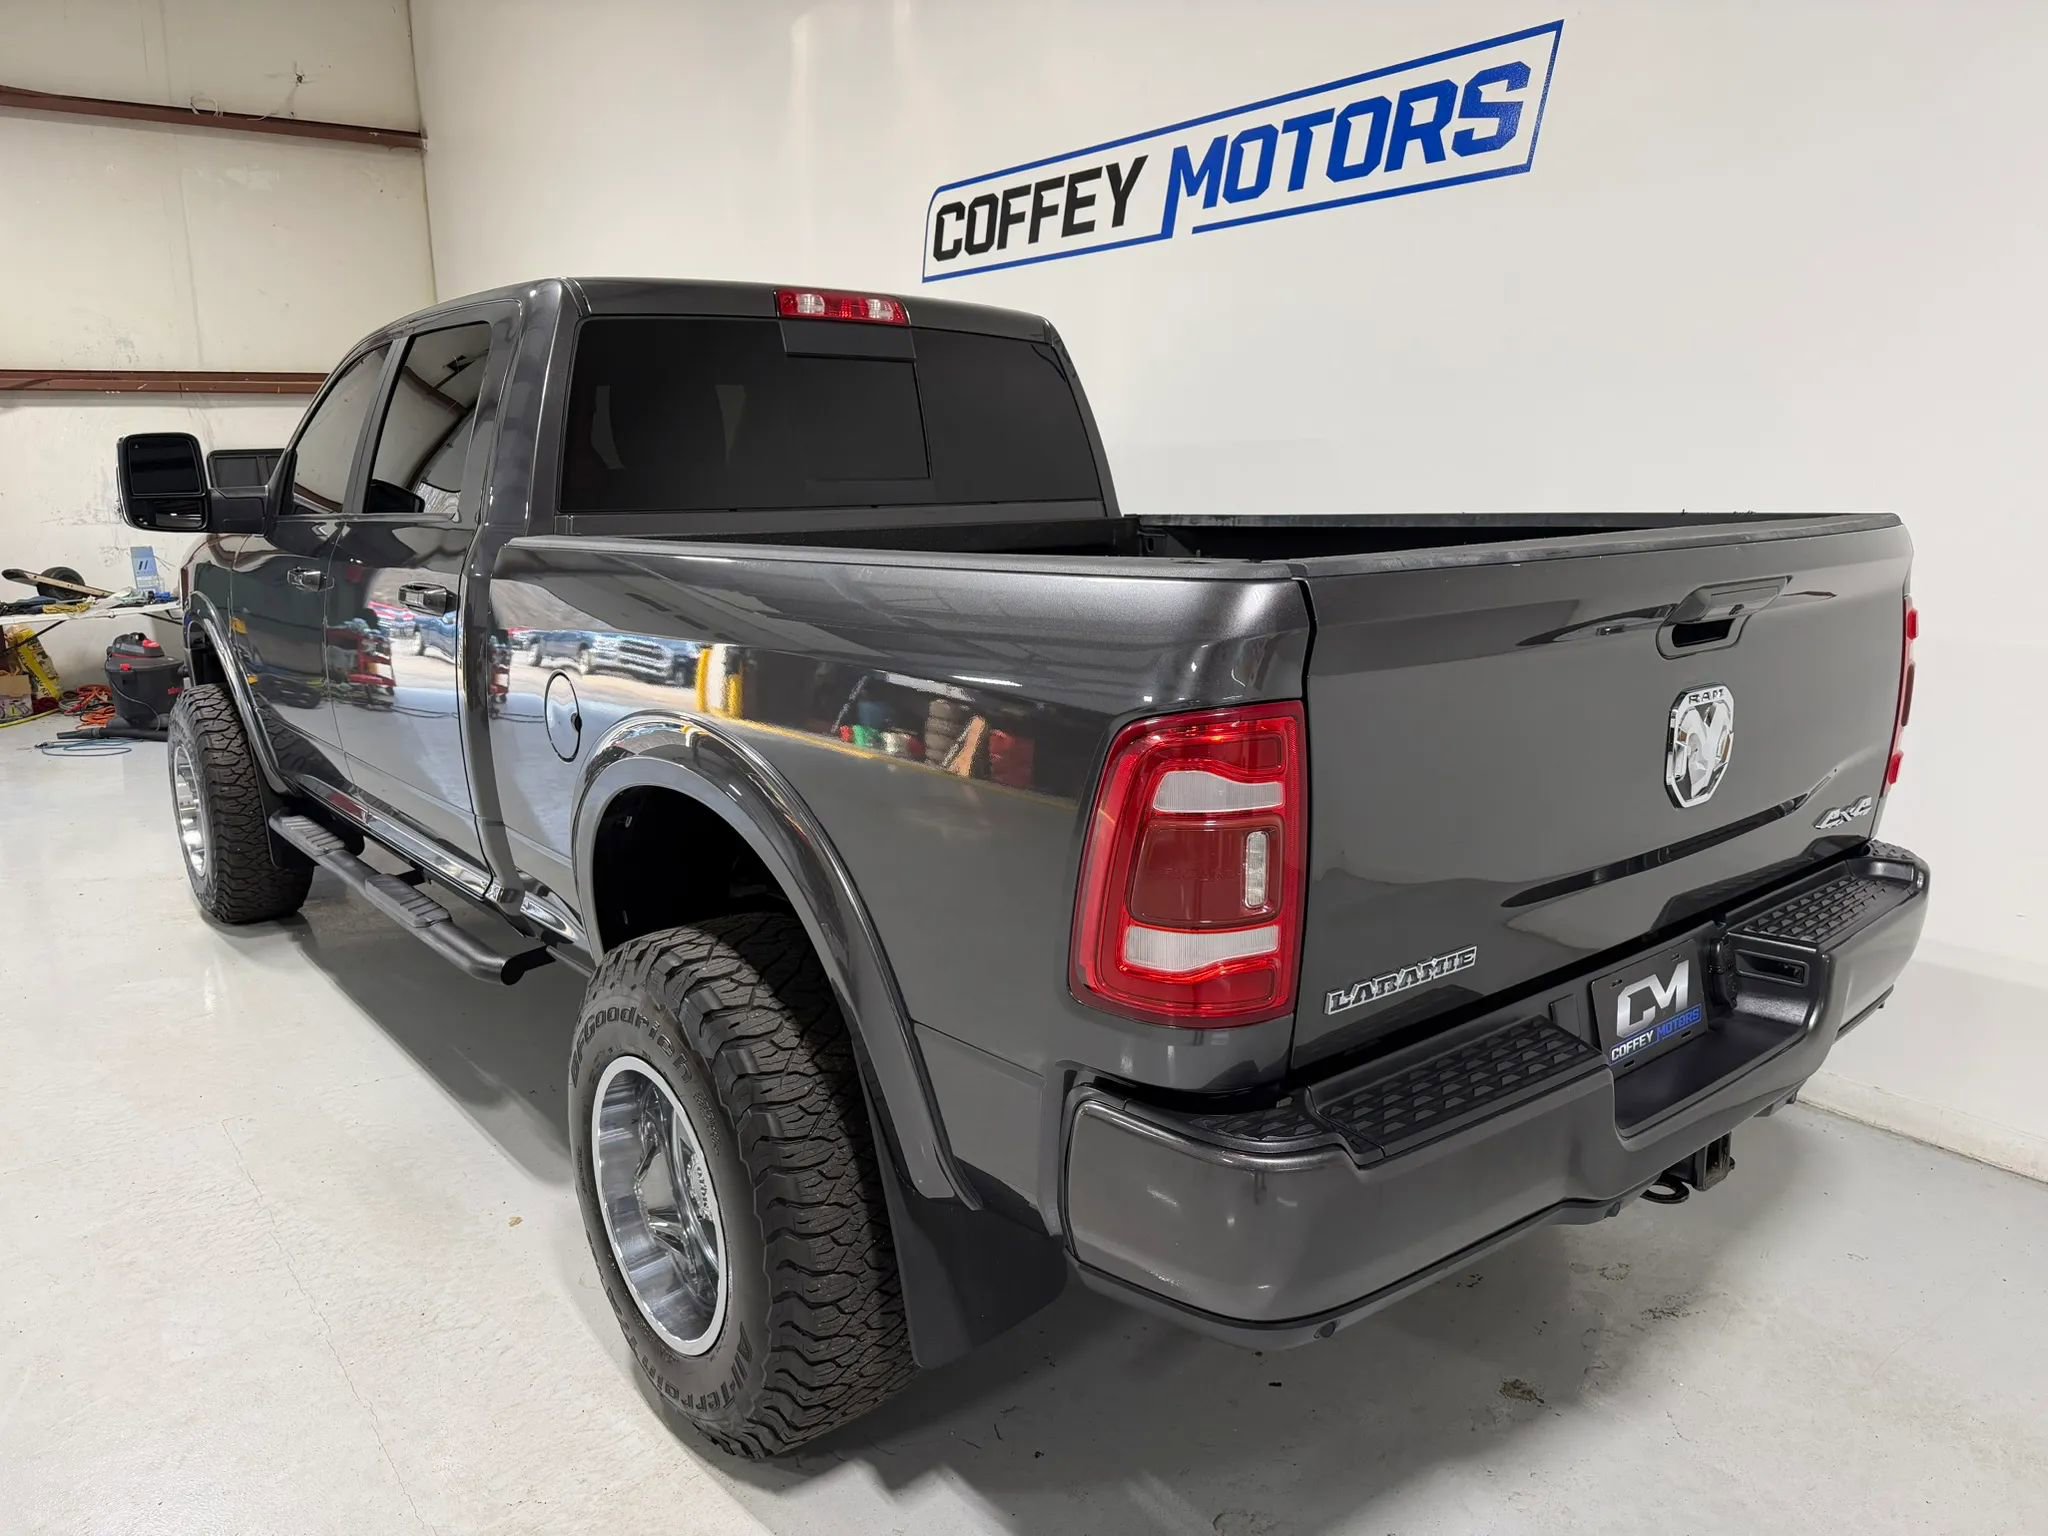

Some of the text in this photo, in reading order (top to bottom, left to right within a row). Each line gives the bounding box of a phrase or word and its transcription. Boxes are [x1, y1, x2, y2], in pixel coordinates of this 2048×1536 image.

[933, 61, 1531, 262] COFFEY MOTORS
[1324, 944, 1477, 1015] LARAMIE
[1617, 960, 1689, 1038] CM
[570, 1006, 694, 1088] BFGoodrich
[1611, 1008, 1700, 1061] COFFEY MOTORS
